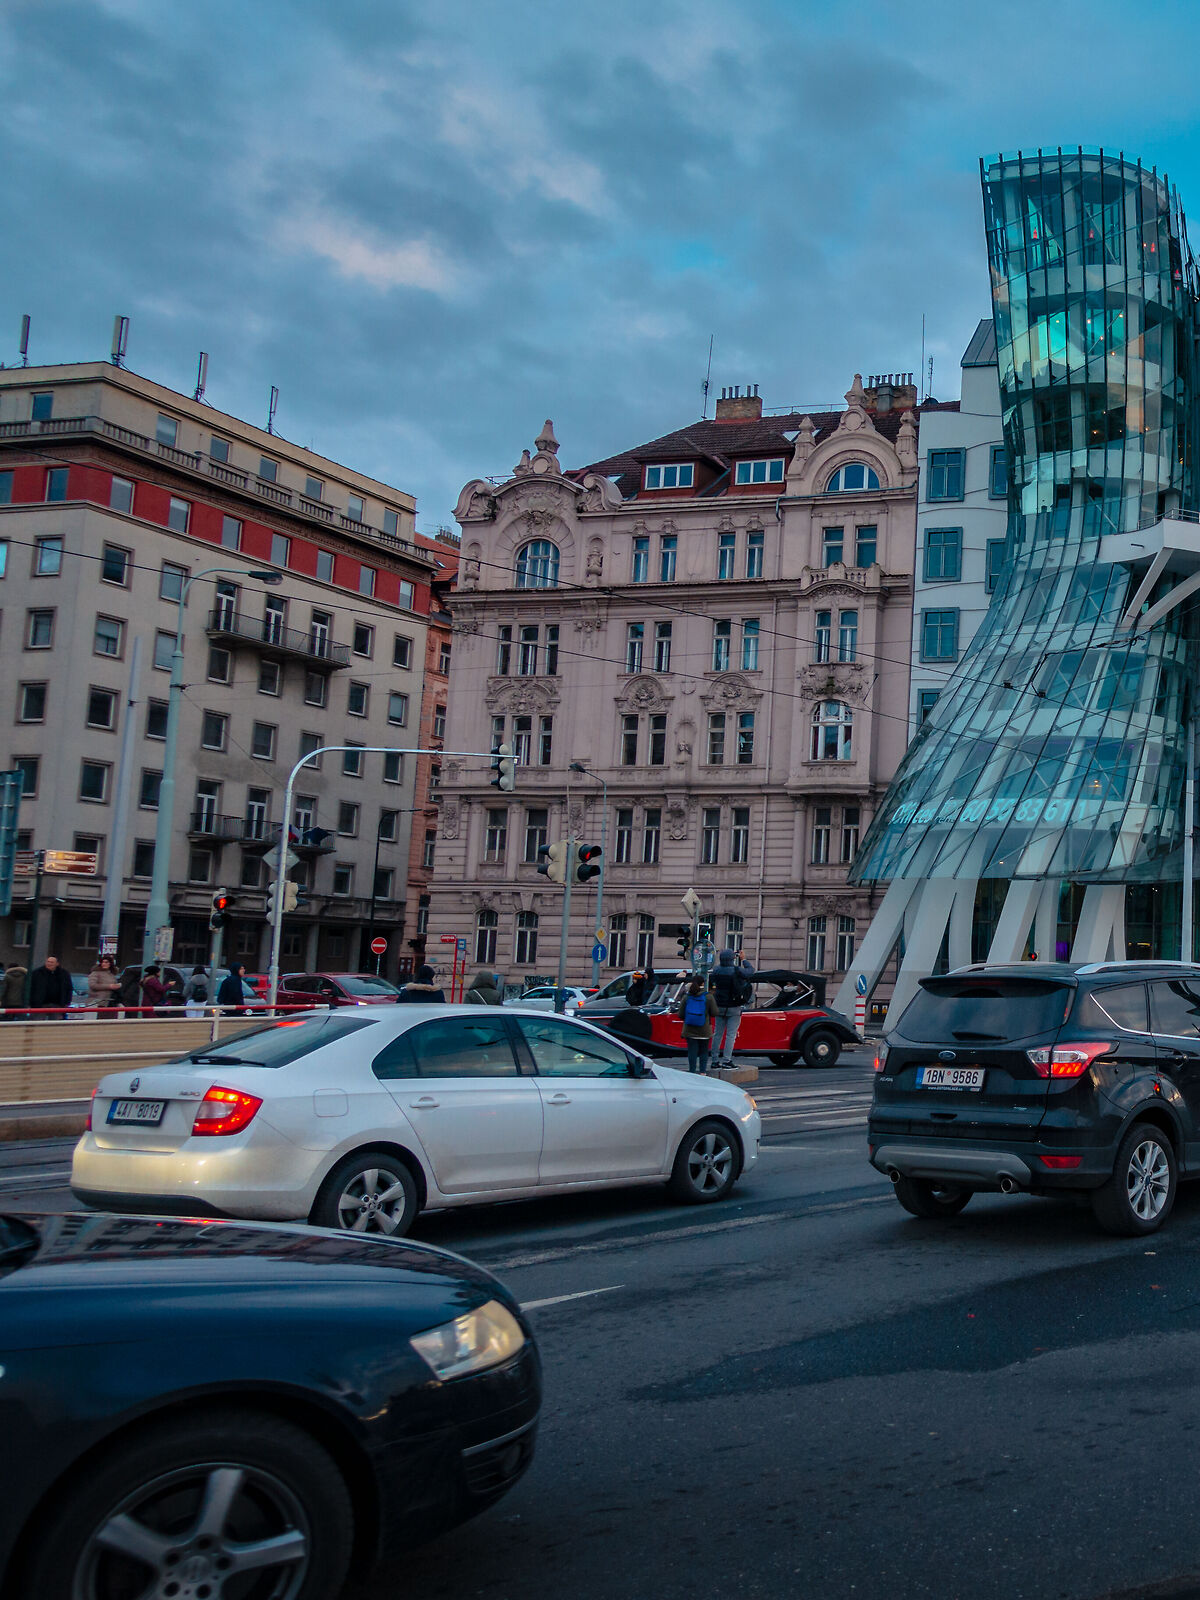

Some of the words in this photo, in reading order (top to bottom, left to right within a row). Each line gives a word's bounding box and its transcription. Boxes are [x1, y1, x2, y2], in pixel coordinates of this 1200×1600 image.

[926, 1069, 946, 1083] 1BN
[952, 1070, 979, 1085] 9586
[138, 1104, 160, 1119] 8019
